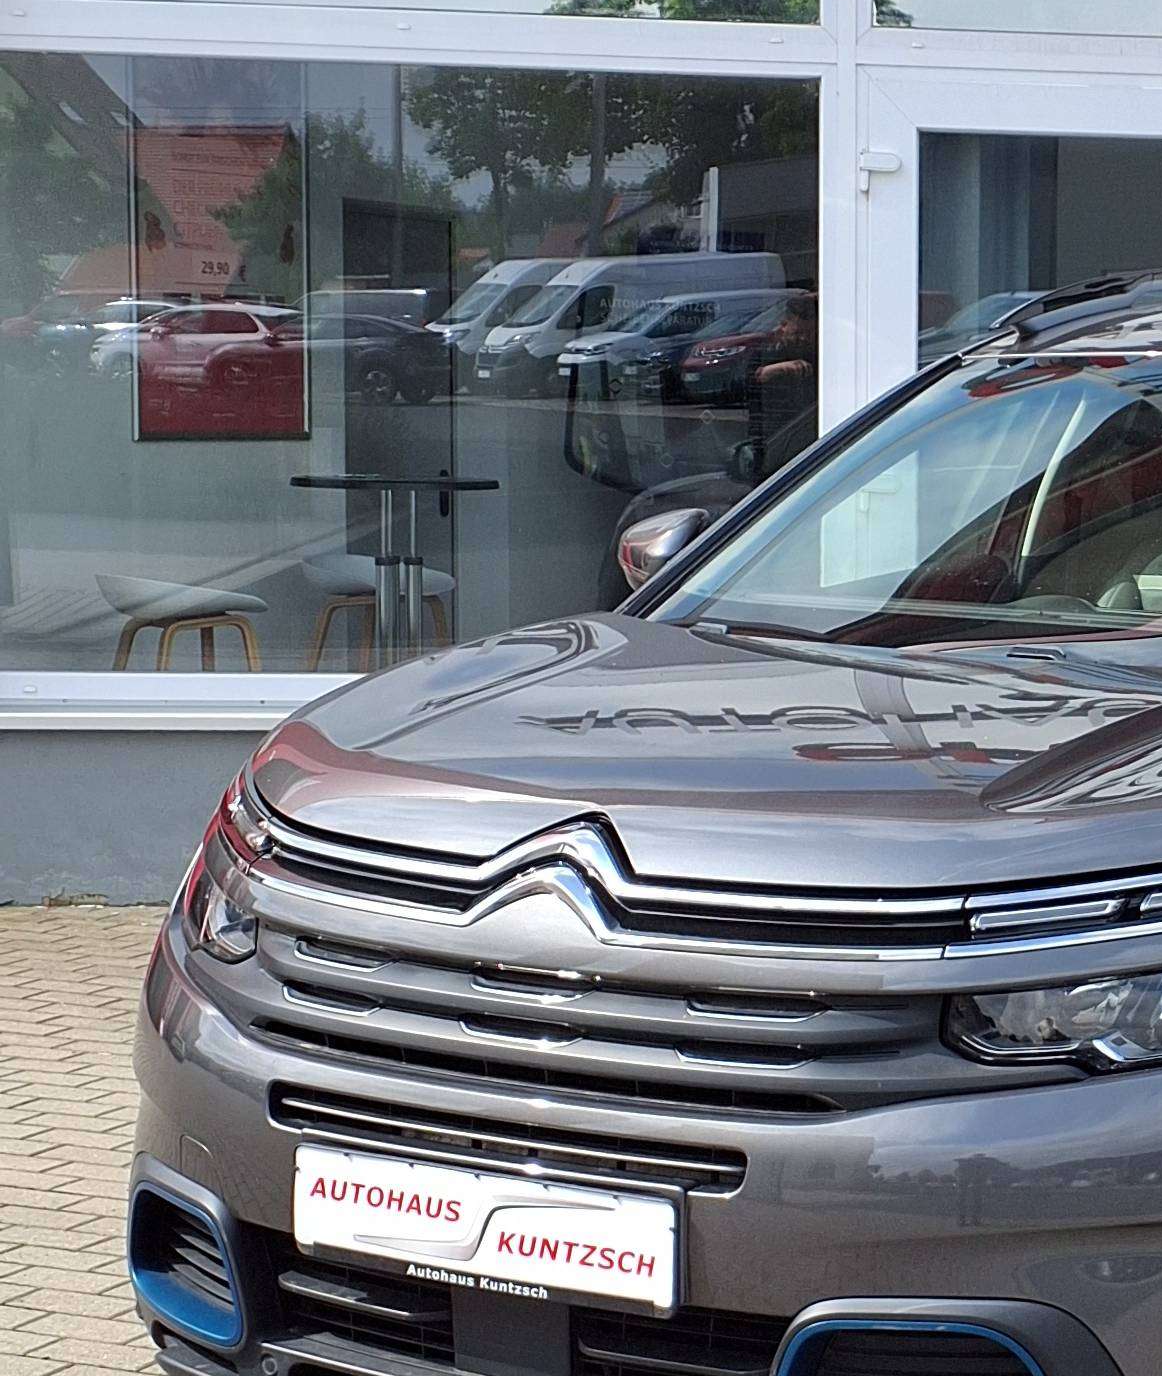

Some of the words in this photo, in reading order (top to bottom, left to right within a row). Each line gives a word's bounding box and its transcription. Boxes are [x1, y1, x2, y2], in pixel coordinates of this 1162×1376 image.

[201, 260, 230, 276] 29,90
[310, 1176, 462, 1223] AUTOHAUS
[497, 1230, 657, 1279] KUNTZSCH
[406, 1263, 475, 1287] Autohaus
[479, 1278, 549, 1301] Kuntzsch
